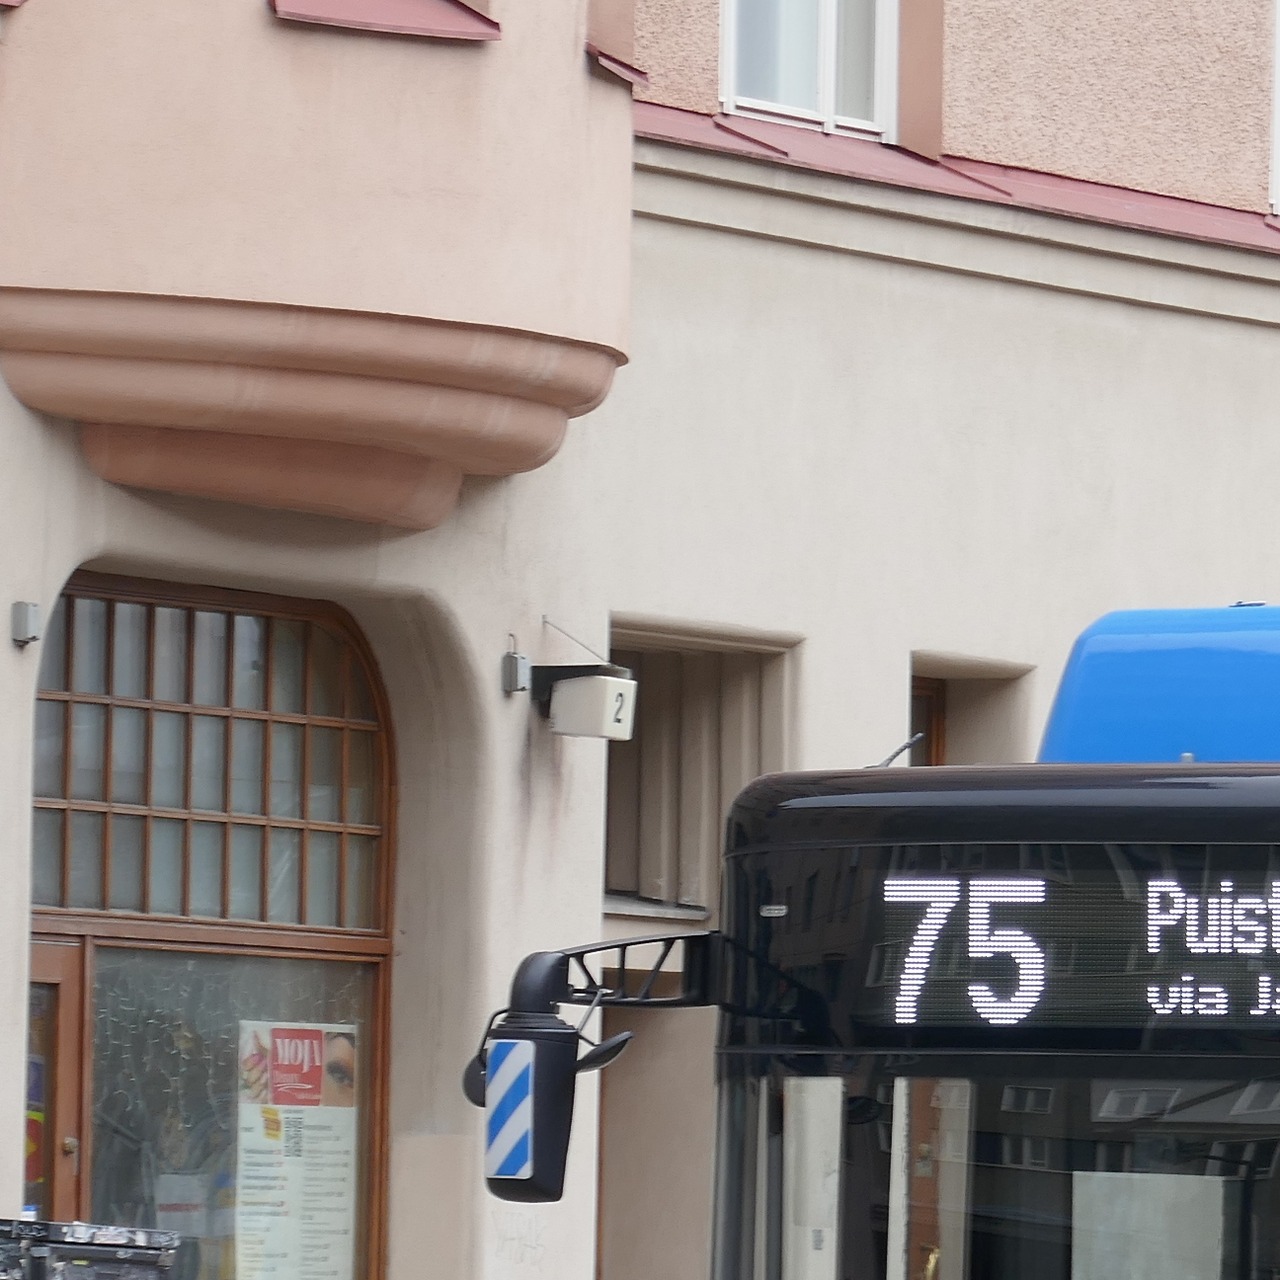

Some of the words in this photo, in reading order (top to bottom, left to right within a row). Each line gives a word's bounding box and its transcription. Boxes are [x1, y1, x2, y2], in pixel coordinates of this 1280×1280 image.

[611, 691, 626, 724] 2
[884, 880, 1045, 1024] 75
[1147, 976, 1229, 1015] via
